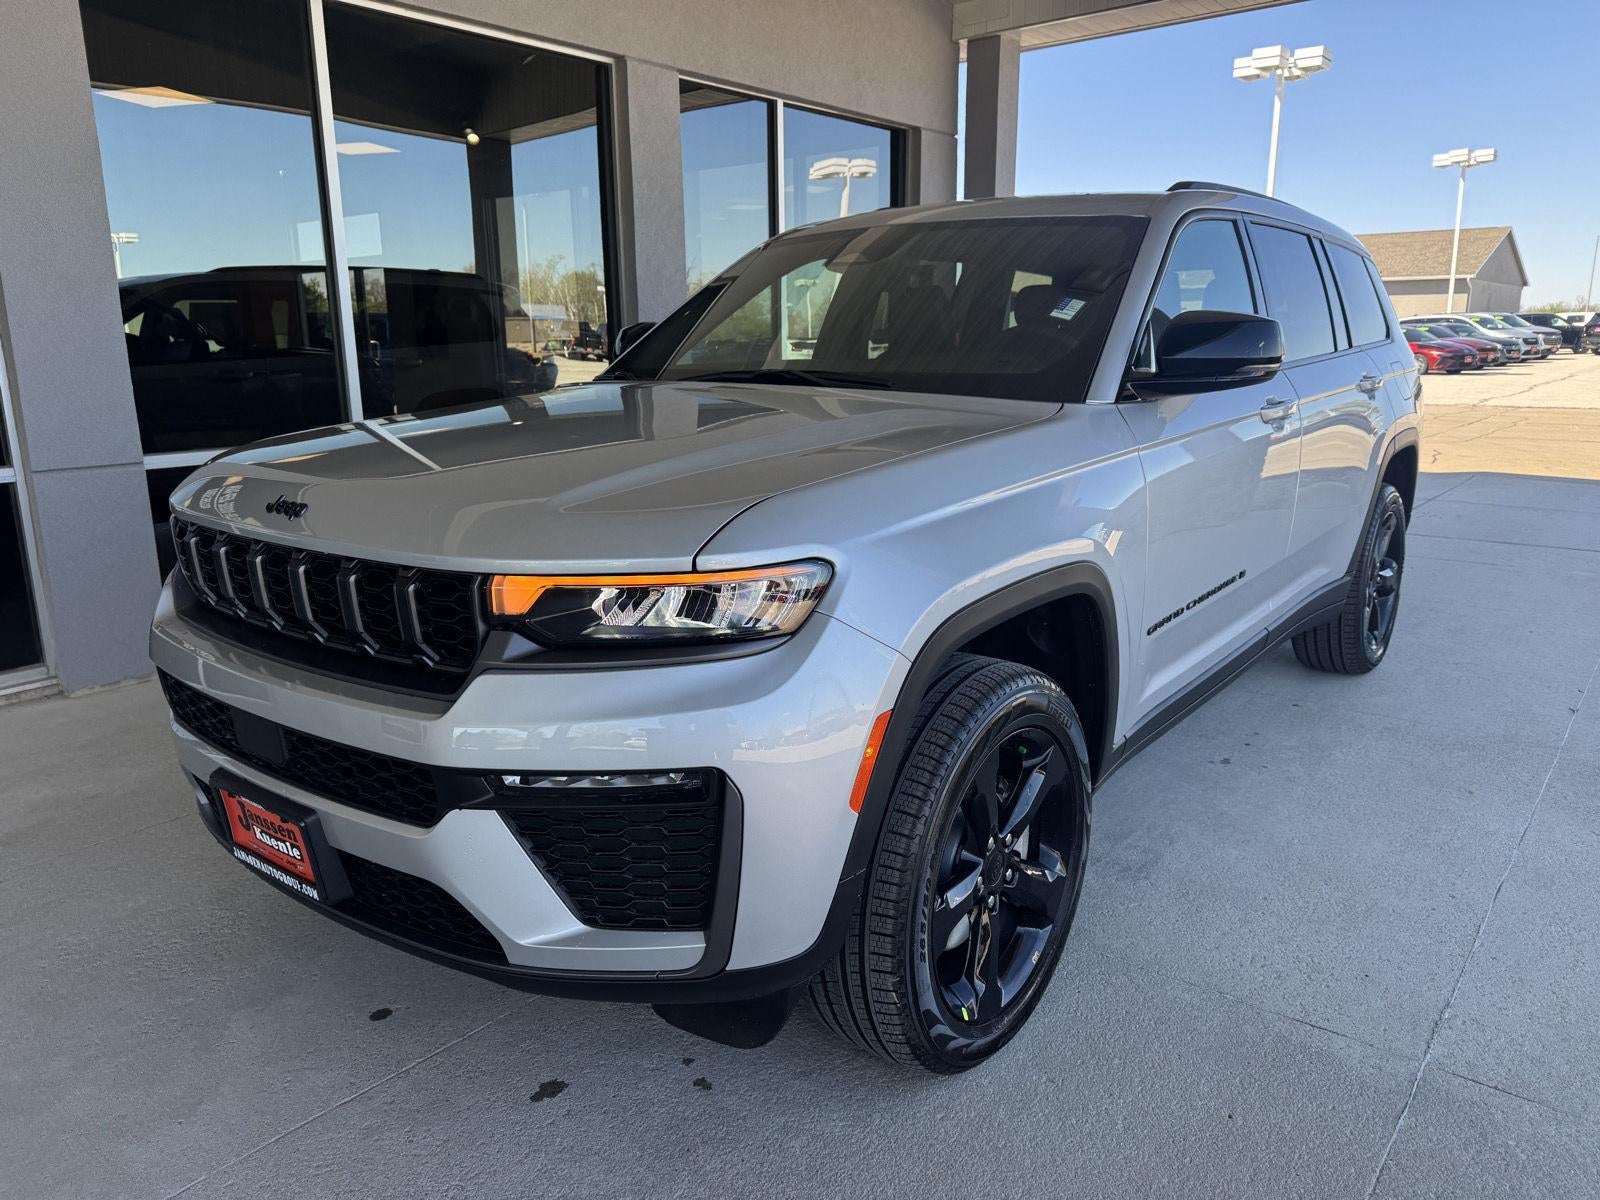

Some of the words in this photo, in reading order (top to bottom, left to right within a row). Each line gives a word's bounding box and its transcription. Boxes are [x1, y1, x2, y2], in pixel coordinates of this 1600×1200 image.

[266, 495, 308, 520] Jeep
[1147, 607, 1184, 636] GRAND
[1186, 574, 1237, 610] CHEROKEE
[238, 800, 298, 842] Janssen
[253, 825, 302, 860] Kuenle
